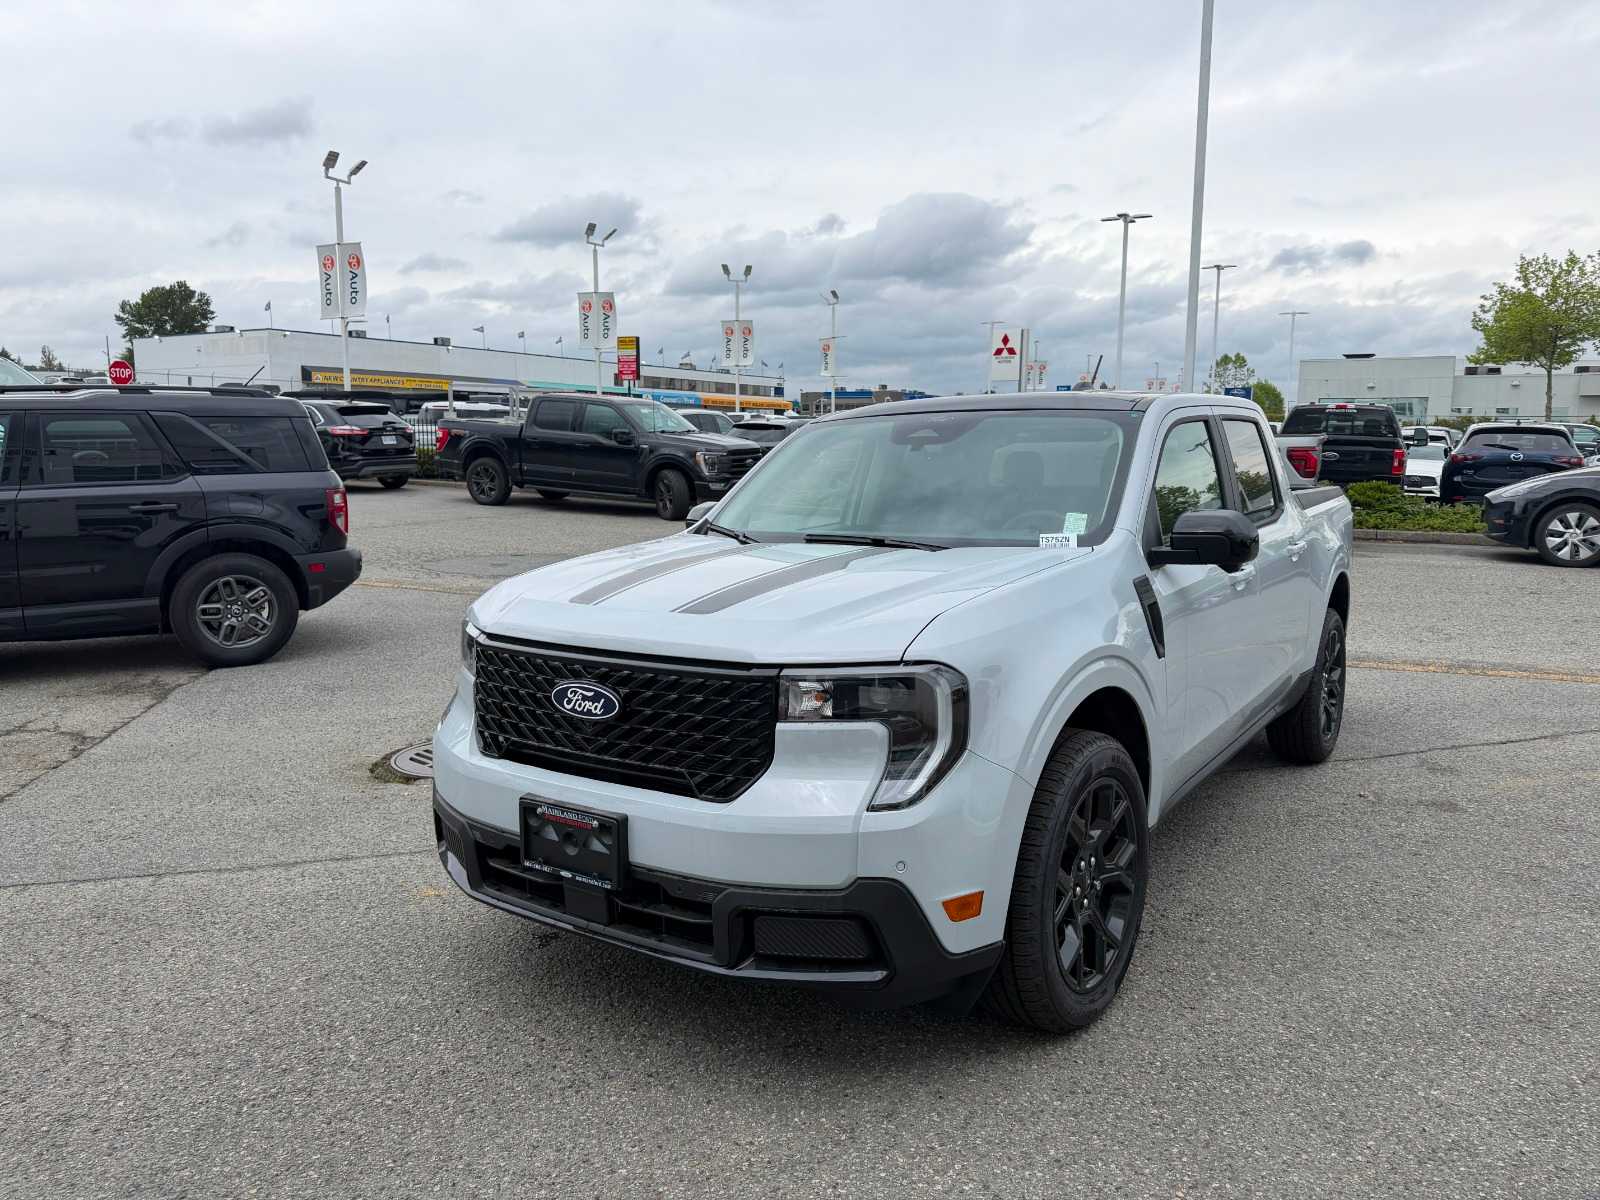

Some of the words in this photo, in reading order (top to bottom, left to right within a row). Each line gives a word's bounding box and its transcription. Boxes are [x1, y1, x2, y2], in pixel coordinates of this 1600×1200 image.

[324, 272, 332, 306] Auto
[349, 270, 359, 305] Auto
[602, 313, 610, 339] Auto
[110, 367, 131, 378] STOP
[563, 688, 604, 714] Ford
[542, 804, 578, 820] MAINLAND
